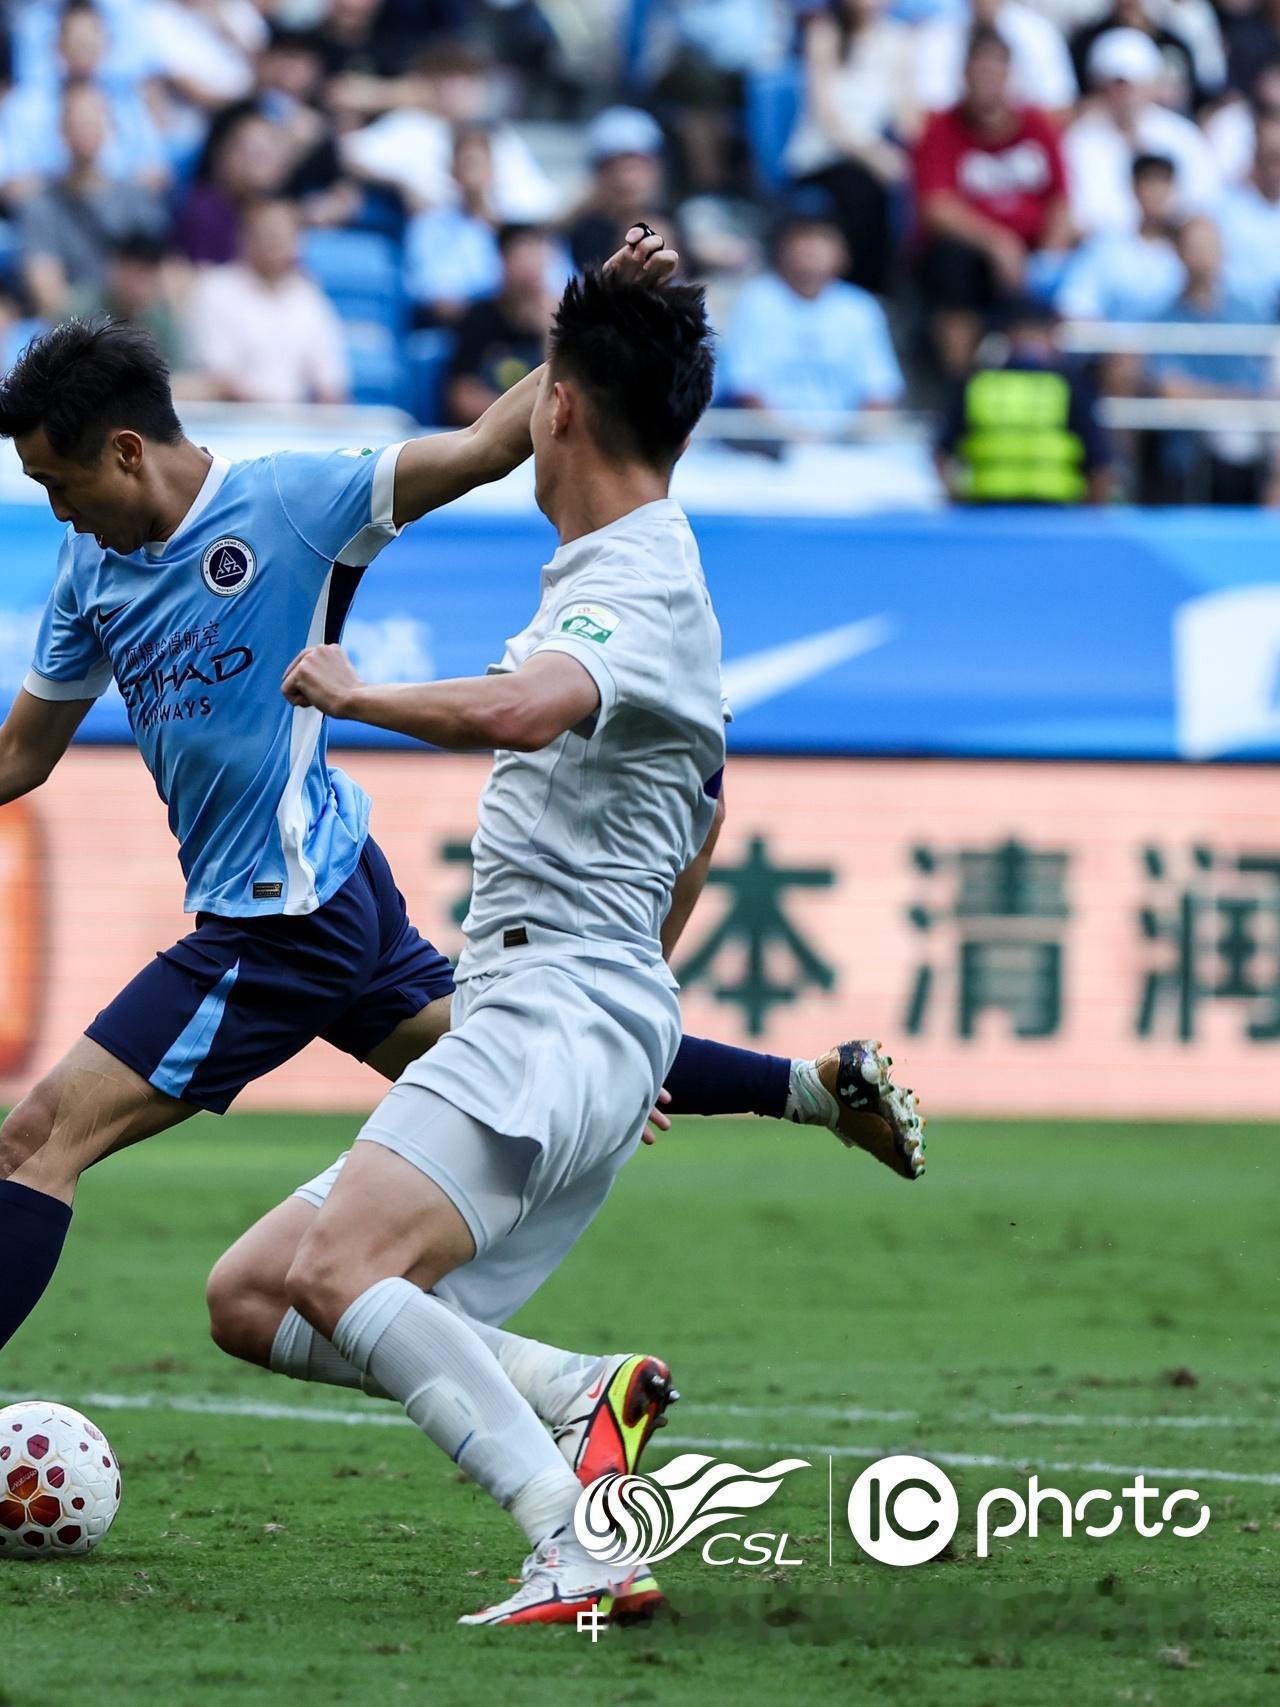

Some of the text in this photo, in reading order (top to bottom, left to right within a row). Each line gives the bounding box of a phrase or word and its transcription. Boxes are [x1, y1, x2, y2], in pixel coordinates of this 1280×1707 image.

[120, 646, 253, 709] ETIHAD
[440, 833, 1280, 1044] 本清润
